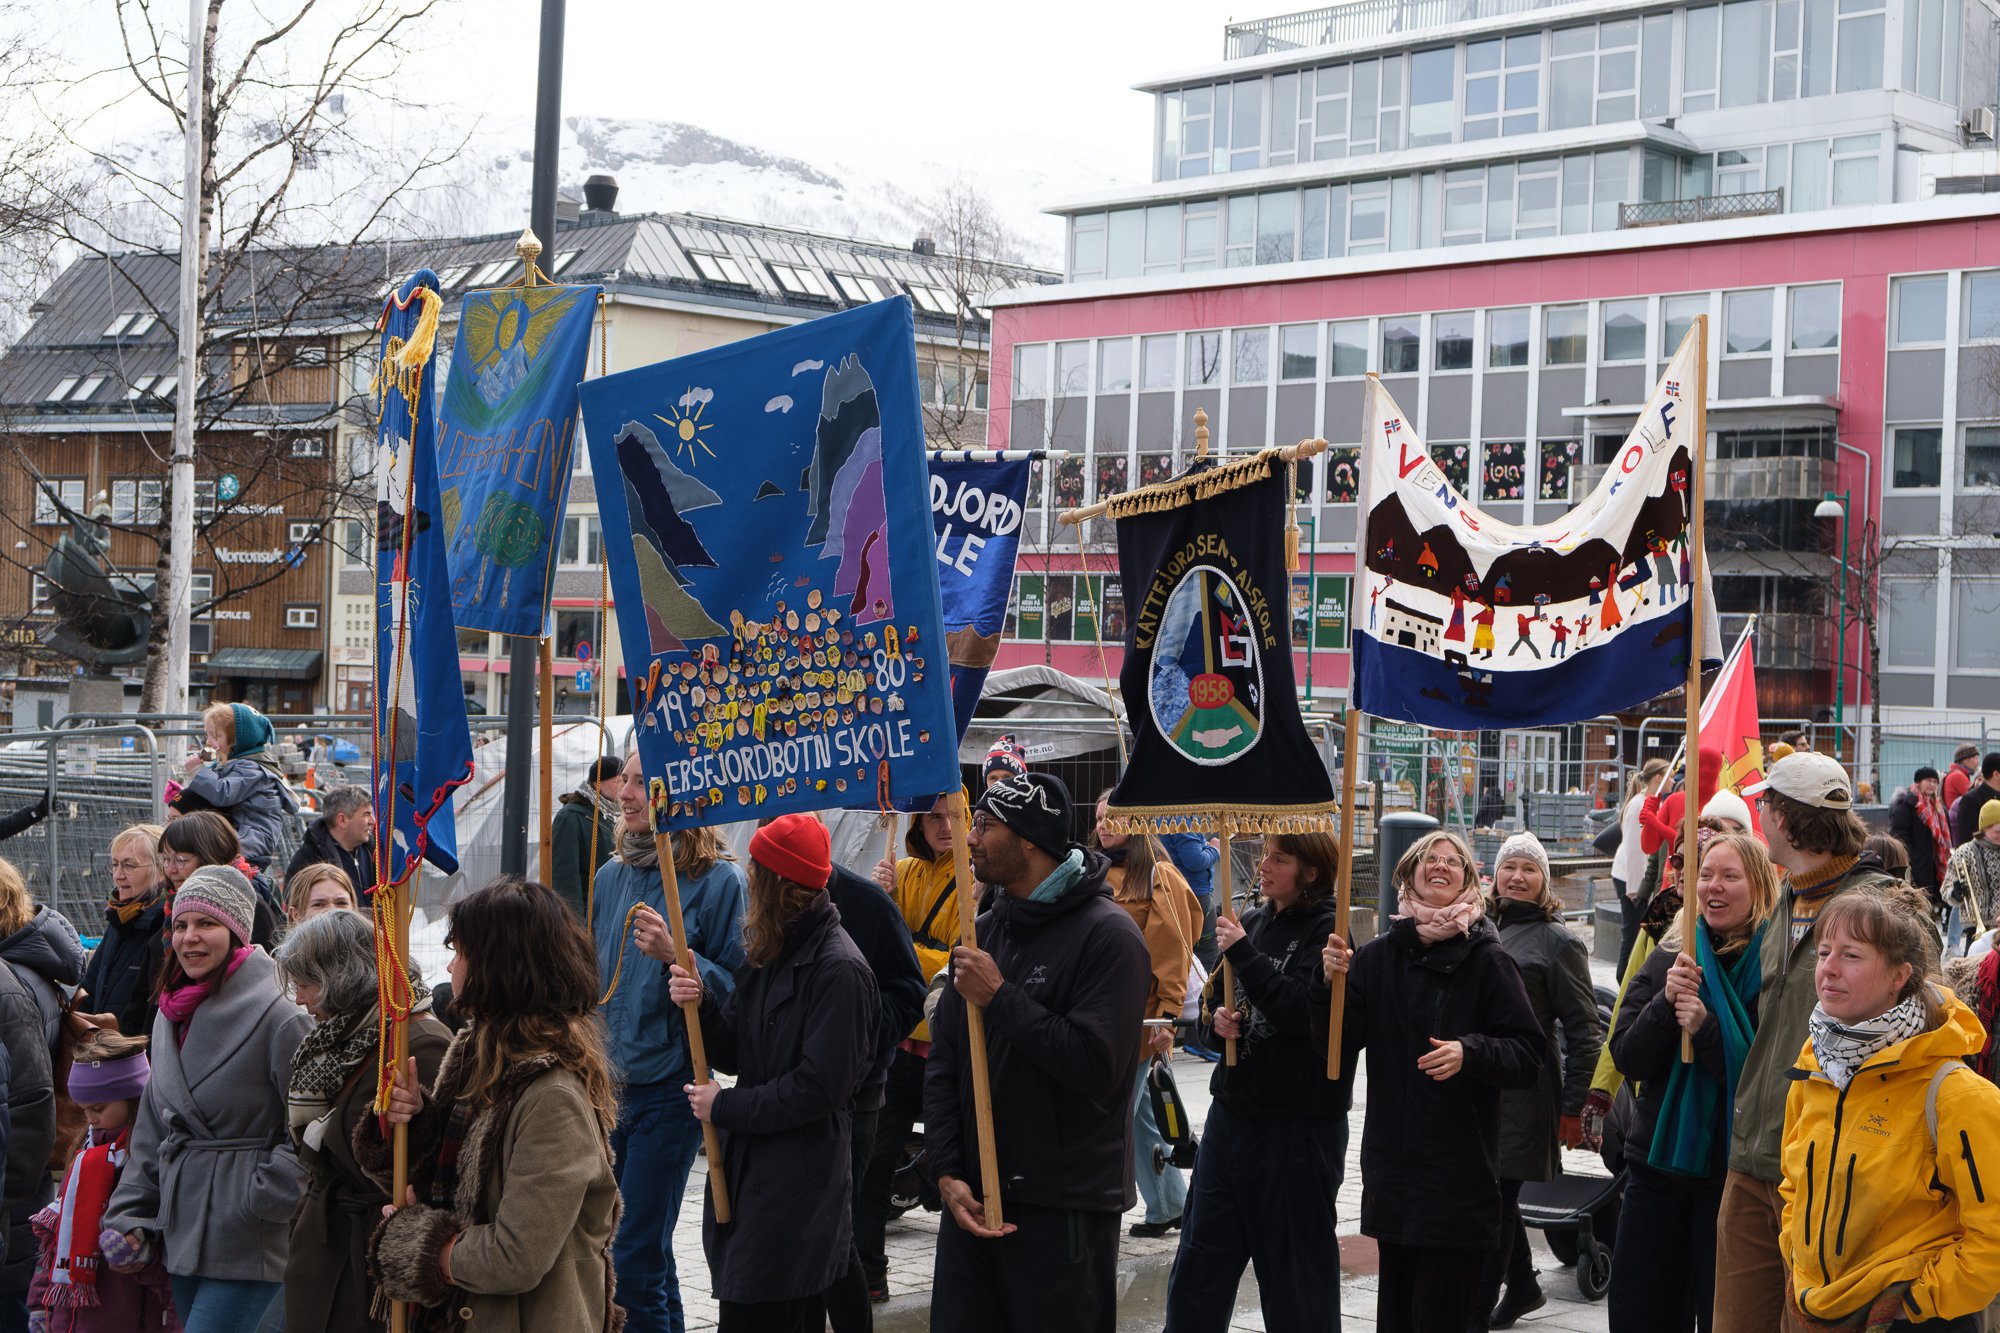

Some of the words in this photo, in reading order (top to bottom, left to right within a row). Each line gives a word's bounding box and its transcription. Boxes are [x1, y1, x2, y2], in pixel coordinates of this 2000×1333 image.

[214, 546, 284, 564] Norconsult
[934, 522, 987, 578] LE
[1316, 610, 1345, 618] FACEBOOK
[1333, 602, 1342, 611] PÅ
[873, 649, 906, 692] 80
[1191, 680, 1230, 703] 1958
[656, 691, 688, 732] 19
[1376, 723, 1400, 733] BOOST
[1402, 725, 1421, 734] YOUR
[665, 733, 832, 796] ERSFJORDBOTN
[834, 719, 914, 766] SKOLE
[1430, 741, 1478, 757] SICS
